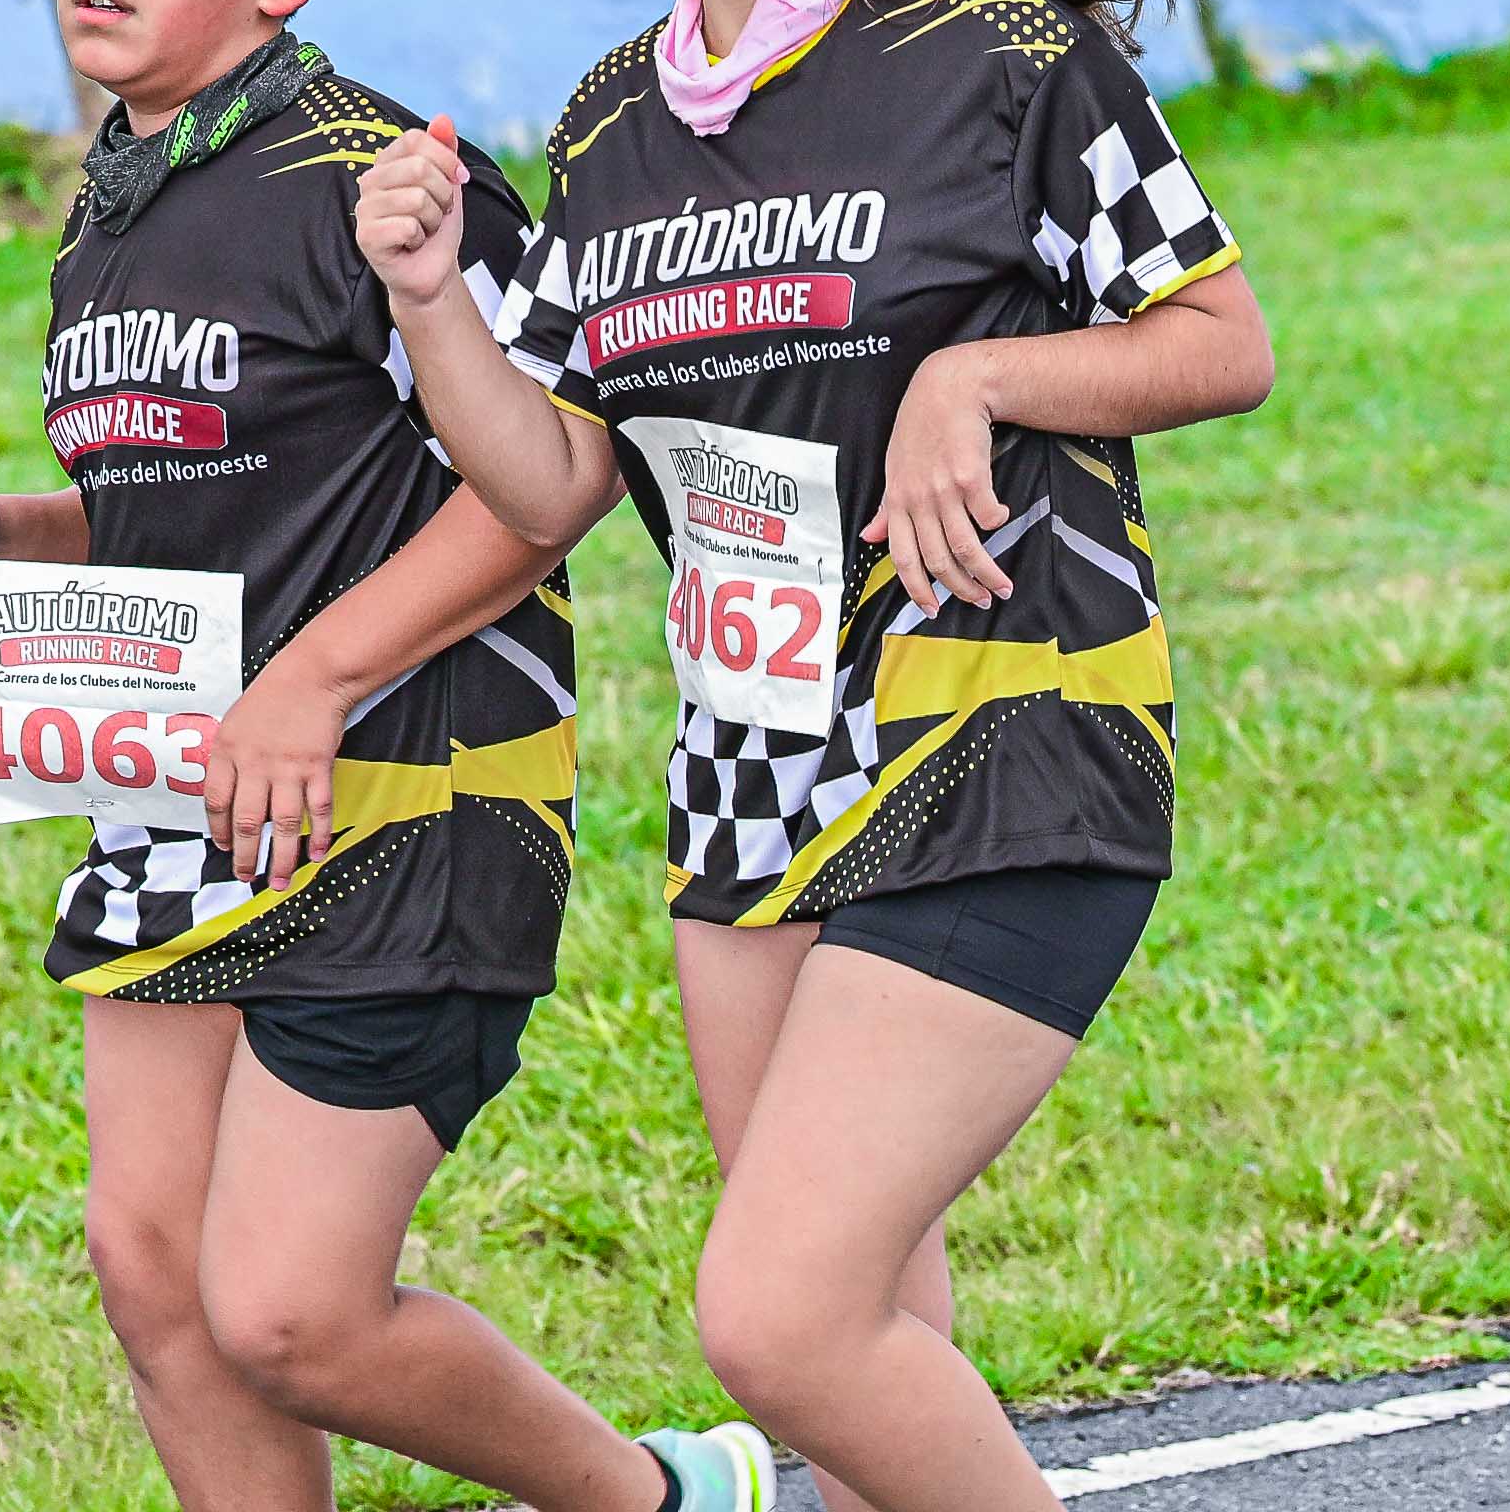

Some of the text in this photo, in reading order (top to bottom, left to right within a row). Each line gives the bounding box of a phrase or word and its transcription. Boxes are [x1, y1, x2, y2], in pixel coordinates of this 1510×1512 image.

[575, 190, 886, 314] AUTÓDROMO
[599, 281, 812, 358] RUNNING RACE
[596, 334, 892, 401] arrera de los Clubes del Noroeste
[48, 398, 184, 461] RUNNIN RACE
[131, 461, 161, 484] del
[165, 452, 269, 482] Noroeste
[722, 505, 766, 540] RACE
[732, 544, 750, 559] del
[751, 546, 799, 566] Noroeste
[668, 559, 822, 682] 4062
[19, 638, 160, 670] RUNNING RACE
[42, 671, 58, 686] de
[60, 672, 77, 687] los
[79, 674, 121, 689] Clubes
[122, 676, 142, 691] del
[143, 677, 197, 693] Noroeste
